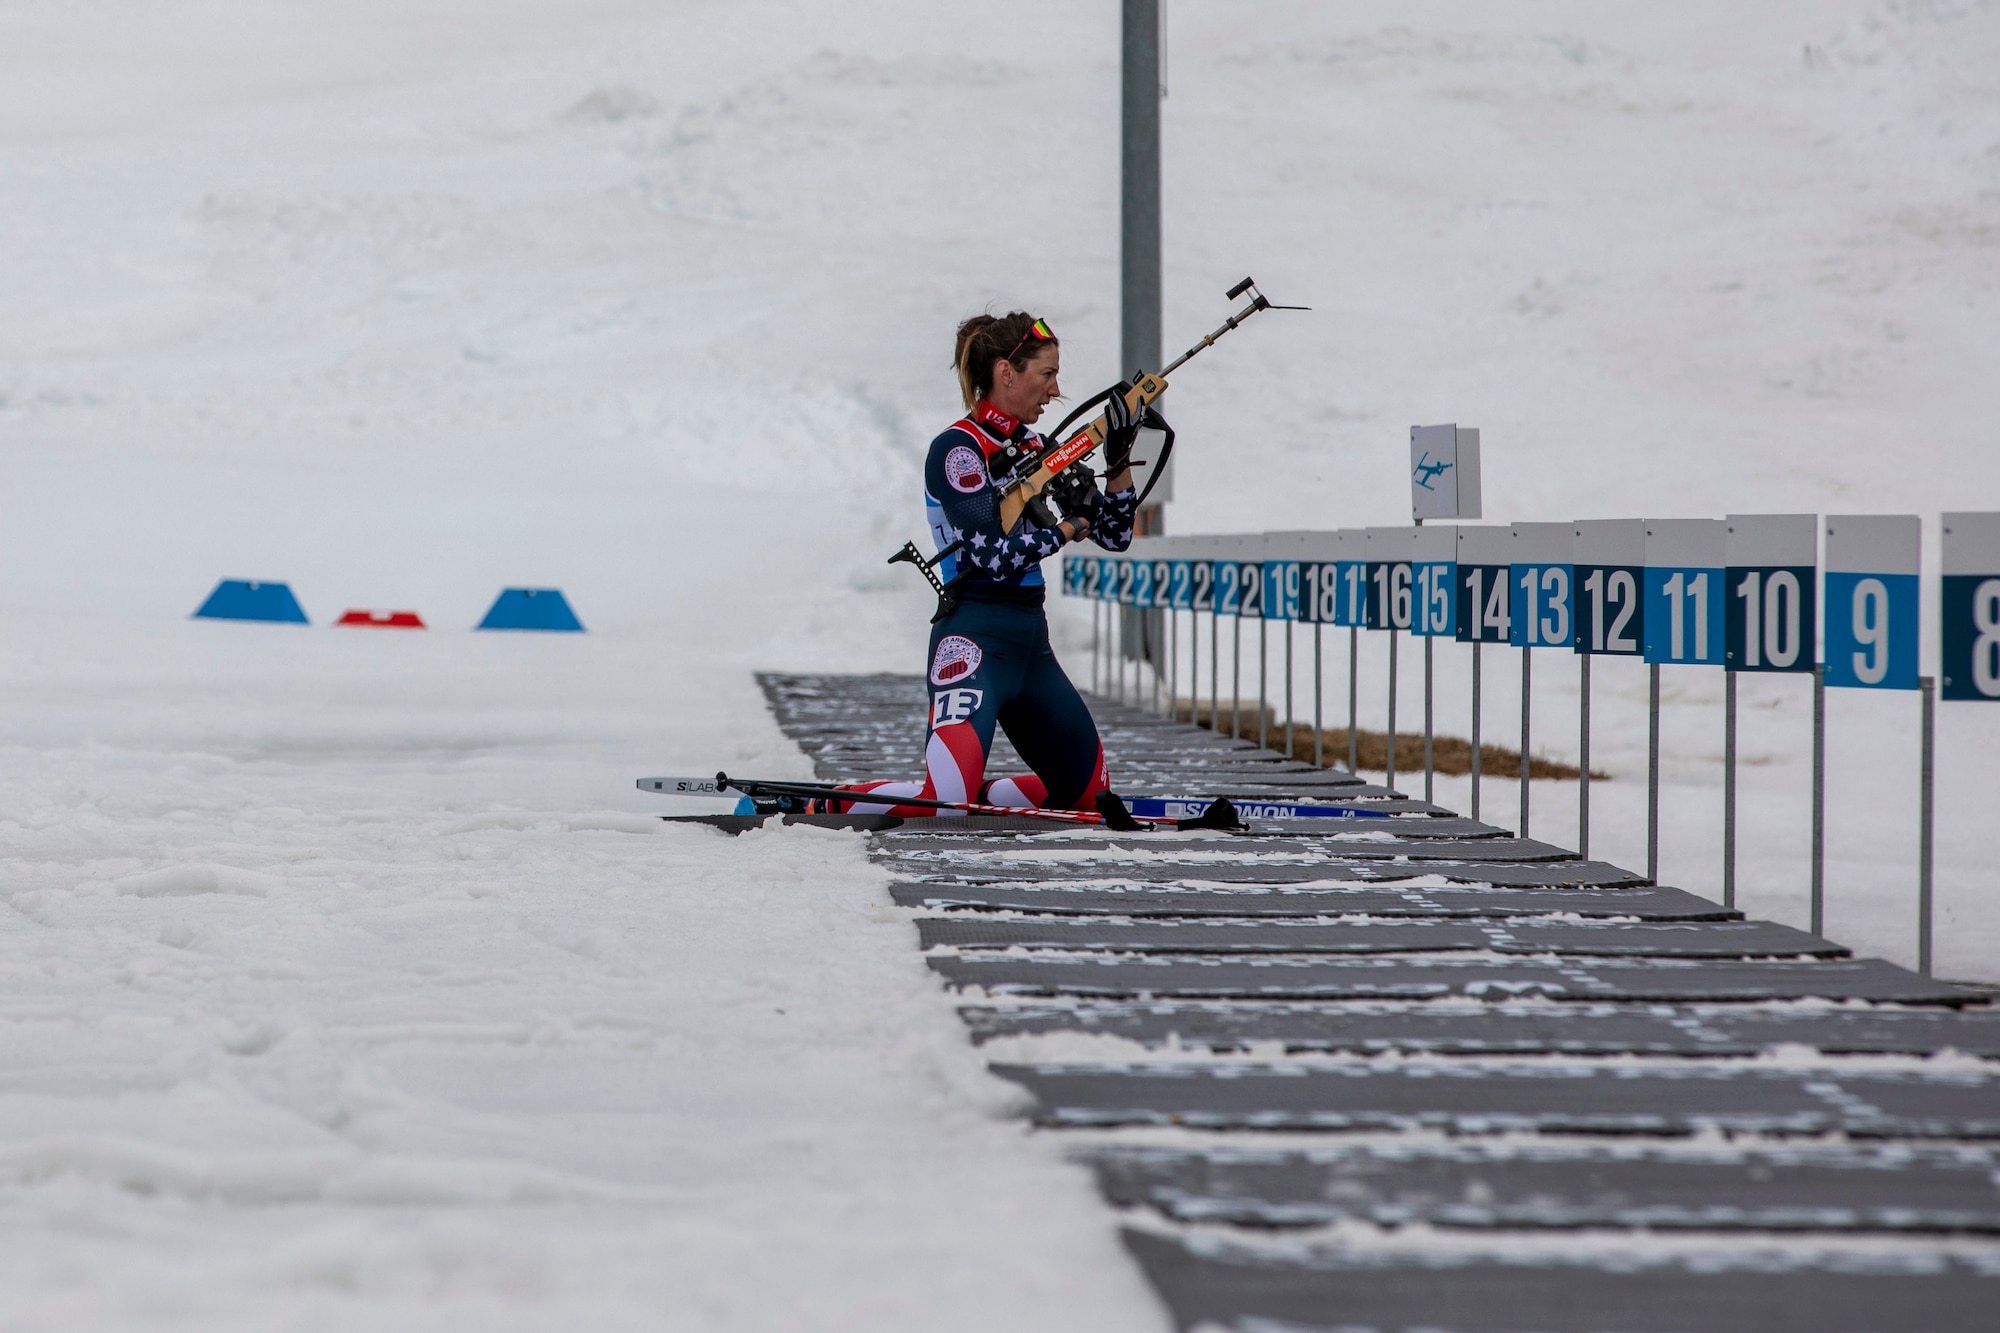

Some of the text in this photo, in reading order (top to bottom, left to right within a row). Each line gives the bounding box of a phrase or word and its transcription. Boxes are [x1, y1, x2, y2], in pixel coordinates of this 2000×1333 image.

[985, 409, 1010, 431] USA
[1046, 435, 1089, 467] VIESSMANN
[1192, 562, 1215, 610] 2
[1240, 564, 1266, 617] 2
[1271, 563, 1299, 619] 19
[1306, 563, 1338, 623] 18
[1373, 563, 1412, 629] 16
[1417, 565, 1449, 633] 15
[1465, 568, 1511, 641] 14
[1520, 567, 1570, 645] 13
[1584, 569, 1637, 652] 12
[1662, 572, 1708, 660] 11
[1736, 570, 1800, 667] 10
[1852, 578, 1889, 685] 9
[1972, 579, 2000, 698] 8
[935, 691, 979, 724] 13
[1185, 803, 1297, 818] SMON
